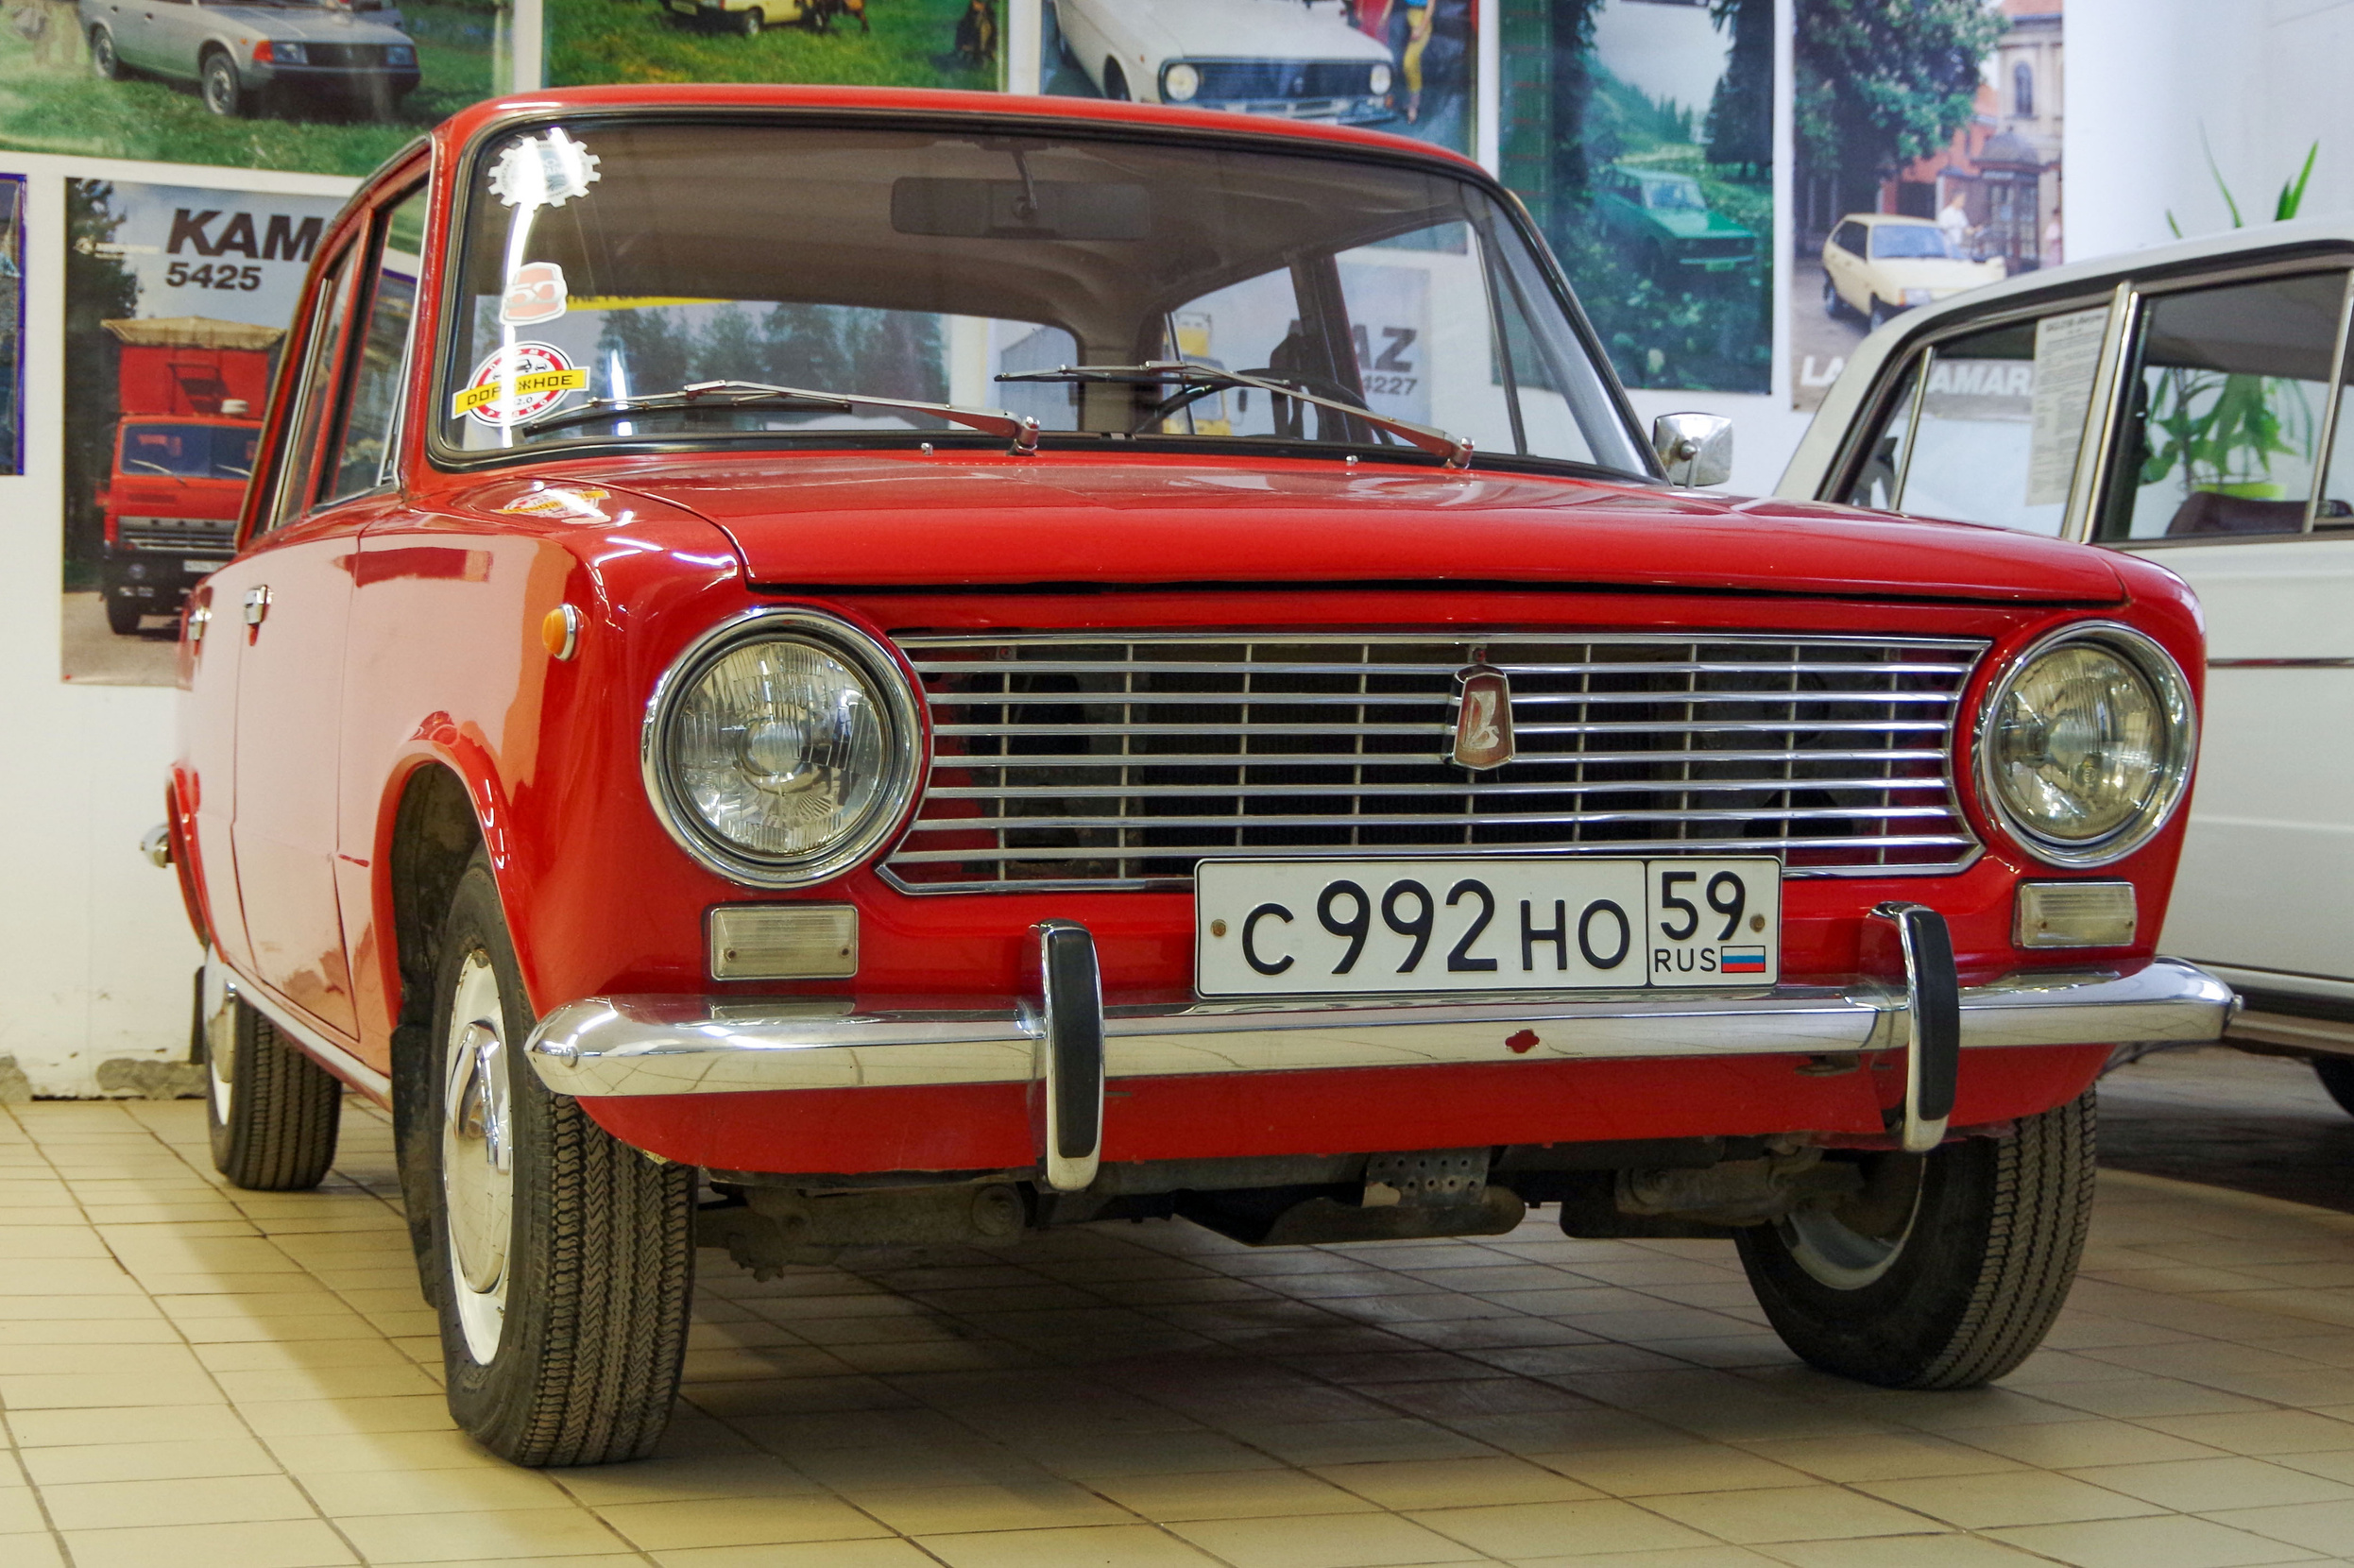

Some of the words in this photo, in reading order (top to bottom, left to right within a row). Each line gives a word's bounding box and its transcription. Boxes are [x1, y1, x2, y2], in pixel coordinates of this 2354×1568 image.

[165, 262, 261, 291] 5425
[1352, 324, 1416, 372] AZ
[467, 374, 573, 406] ДОРЖНОЕ
[1927, 363, 2032, 395] AMAR
[1661, 871, 1746, 941] 59
[1654, 947, 1716, 973] RUS
